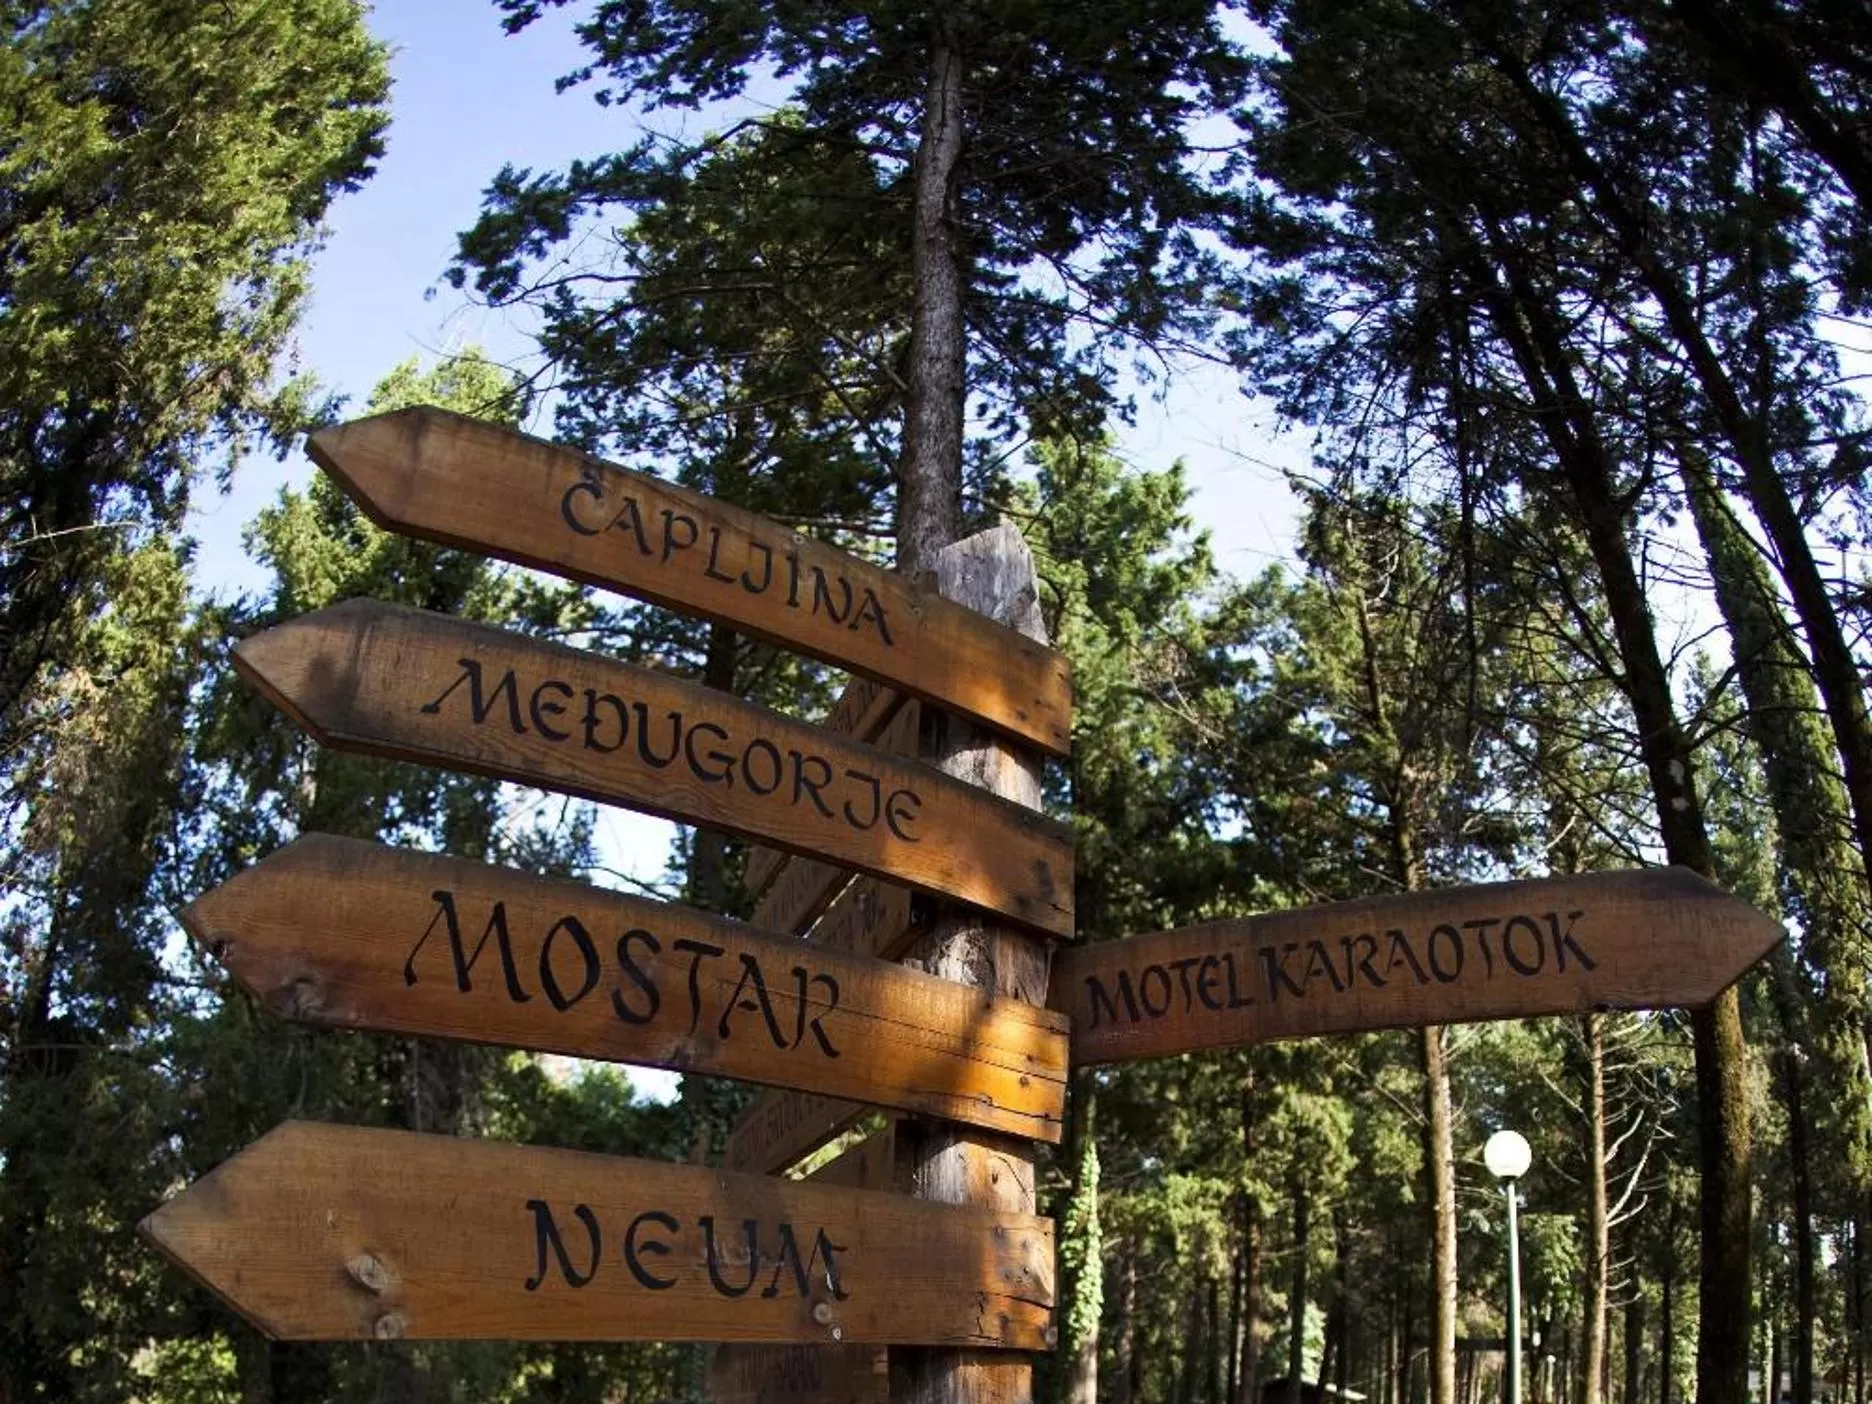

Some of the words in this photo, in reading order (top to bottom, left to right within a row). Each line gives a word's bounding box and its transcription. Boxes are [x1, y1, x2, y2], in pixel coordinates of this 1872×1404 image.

[561, 468, 895, 647] ČAPLJINA
[420, 658, 923, 843] MEĐUGORJE
[404, 890, 842, 1059] MOSTAR
[1084, 953, 1256, 1030] MOTEL
[1259, 909, 1598, 1003] KARAOTOK
[524, 1199, 849, 1301] NEUM
